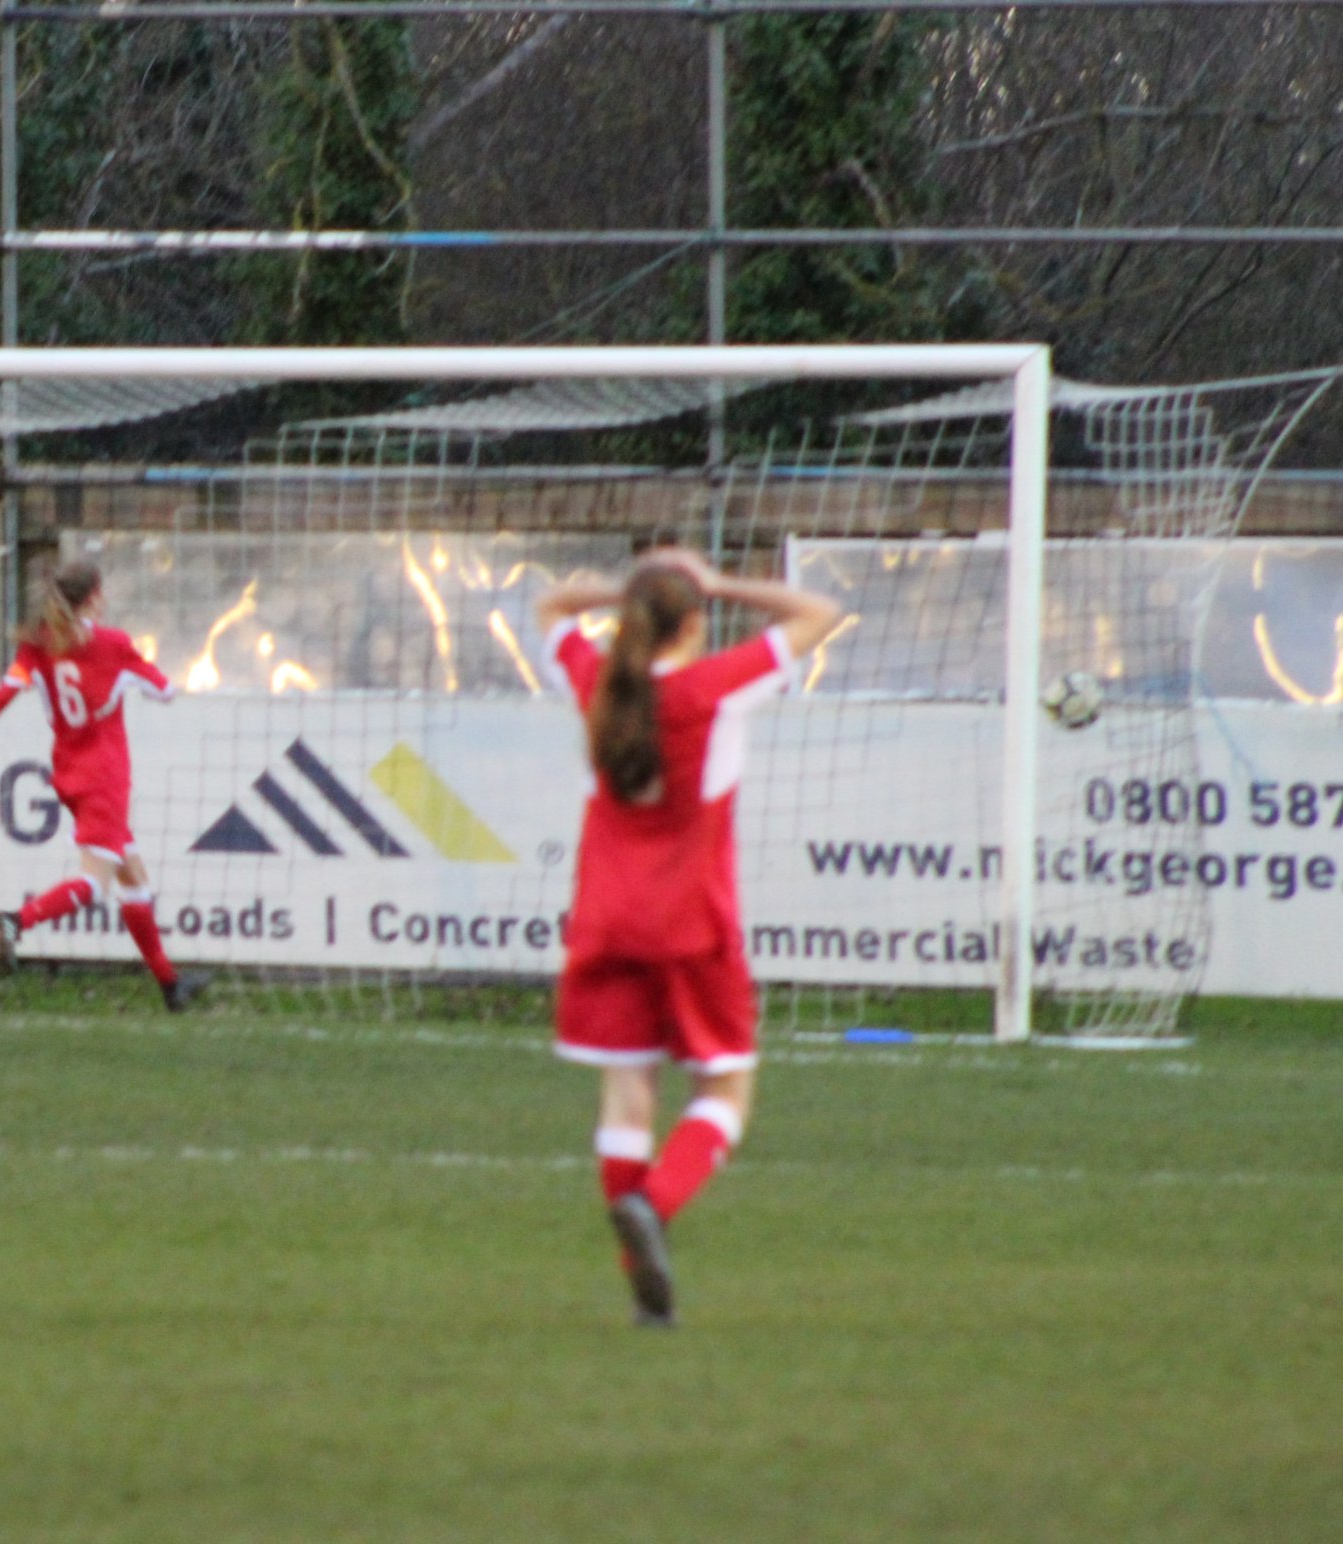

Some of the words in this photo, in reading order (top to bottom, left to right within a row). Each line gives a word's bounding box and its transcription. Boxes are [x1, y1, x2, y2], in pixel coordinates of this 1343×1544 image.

[54, 660, 88, 728] 6
[1086, 777, 1228, 826] 0800
[807, 836, 1343, 900] www.ickgeorge
[369, 901, 574, 949] Concret
[752, 920, 1002, 962] mmercial
[1032, 925, 1195, 971] Waste
